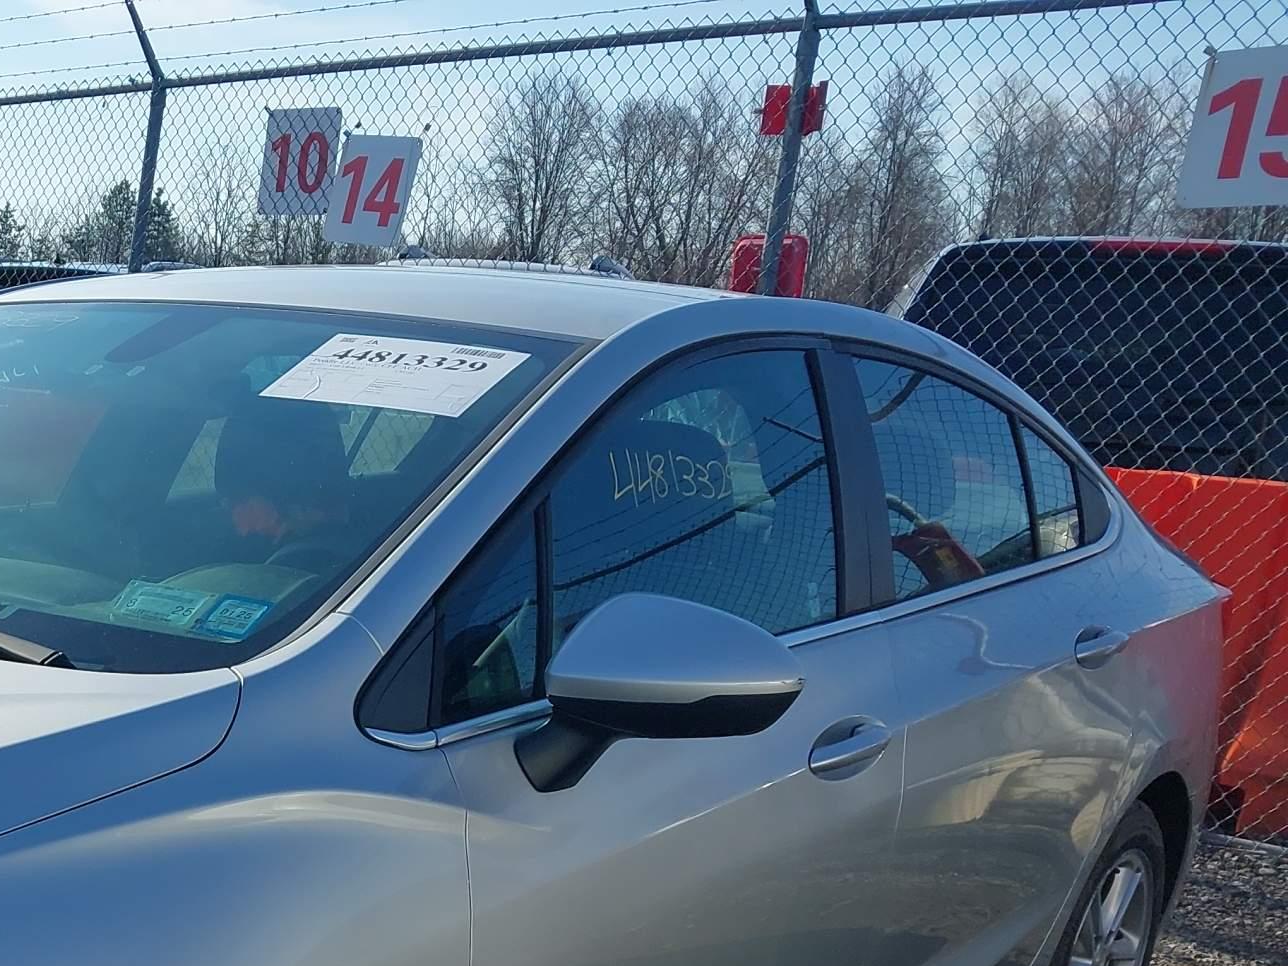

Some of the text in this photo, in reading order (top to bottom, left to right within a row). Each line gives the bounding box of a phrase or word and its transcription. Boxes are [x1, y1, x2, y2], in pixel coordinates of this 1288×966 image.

[271, 131, 329, 194] 10
[342, 155, 404, 227] 14
[330, 347, 489, 374] 44813329
[171, 605, 195, 618] 25
